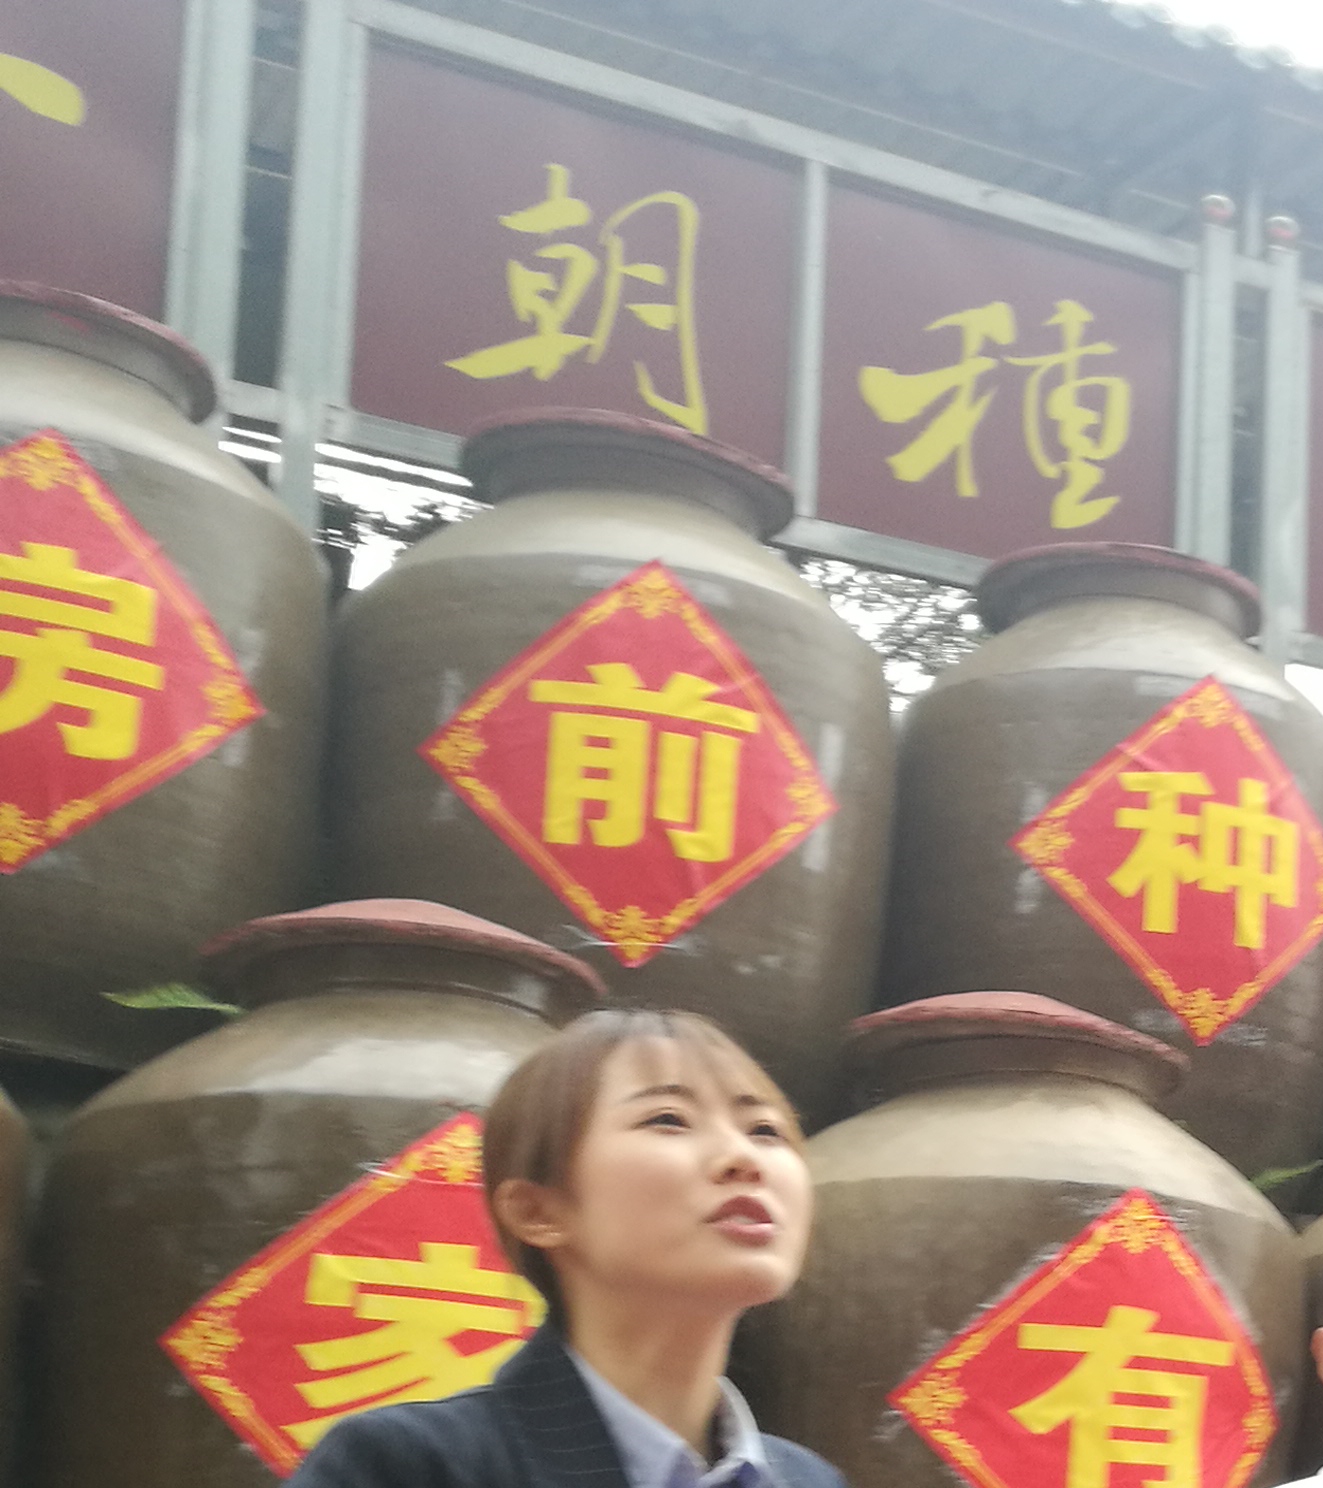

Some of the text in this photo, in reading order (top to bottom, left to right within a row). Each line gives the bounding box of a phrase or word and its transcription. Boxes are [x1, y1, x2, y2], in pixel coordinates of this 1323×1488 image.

[444, 164, 709, 435] 朝
[859, 299, 1131, 529] 種
[528, 661, 760, 865] 前
[1107, 770, 1298, 951] 种
